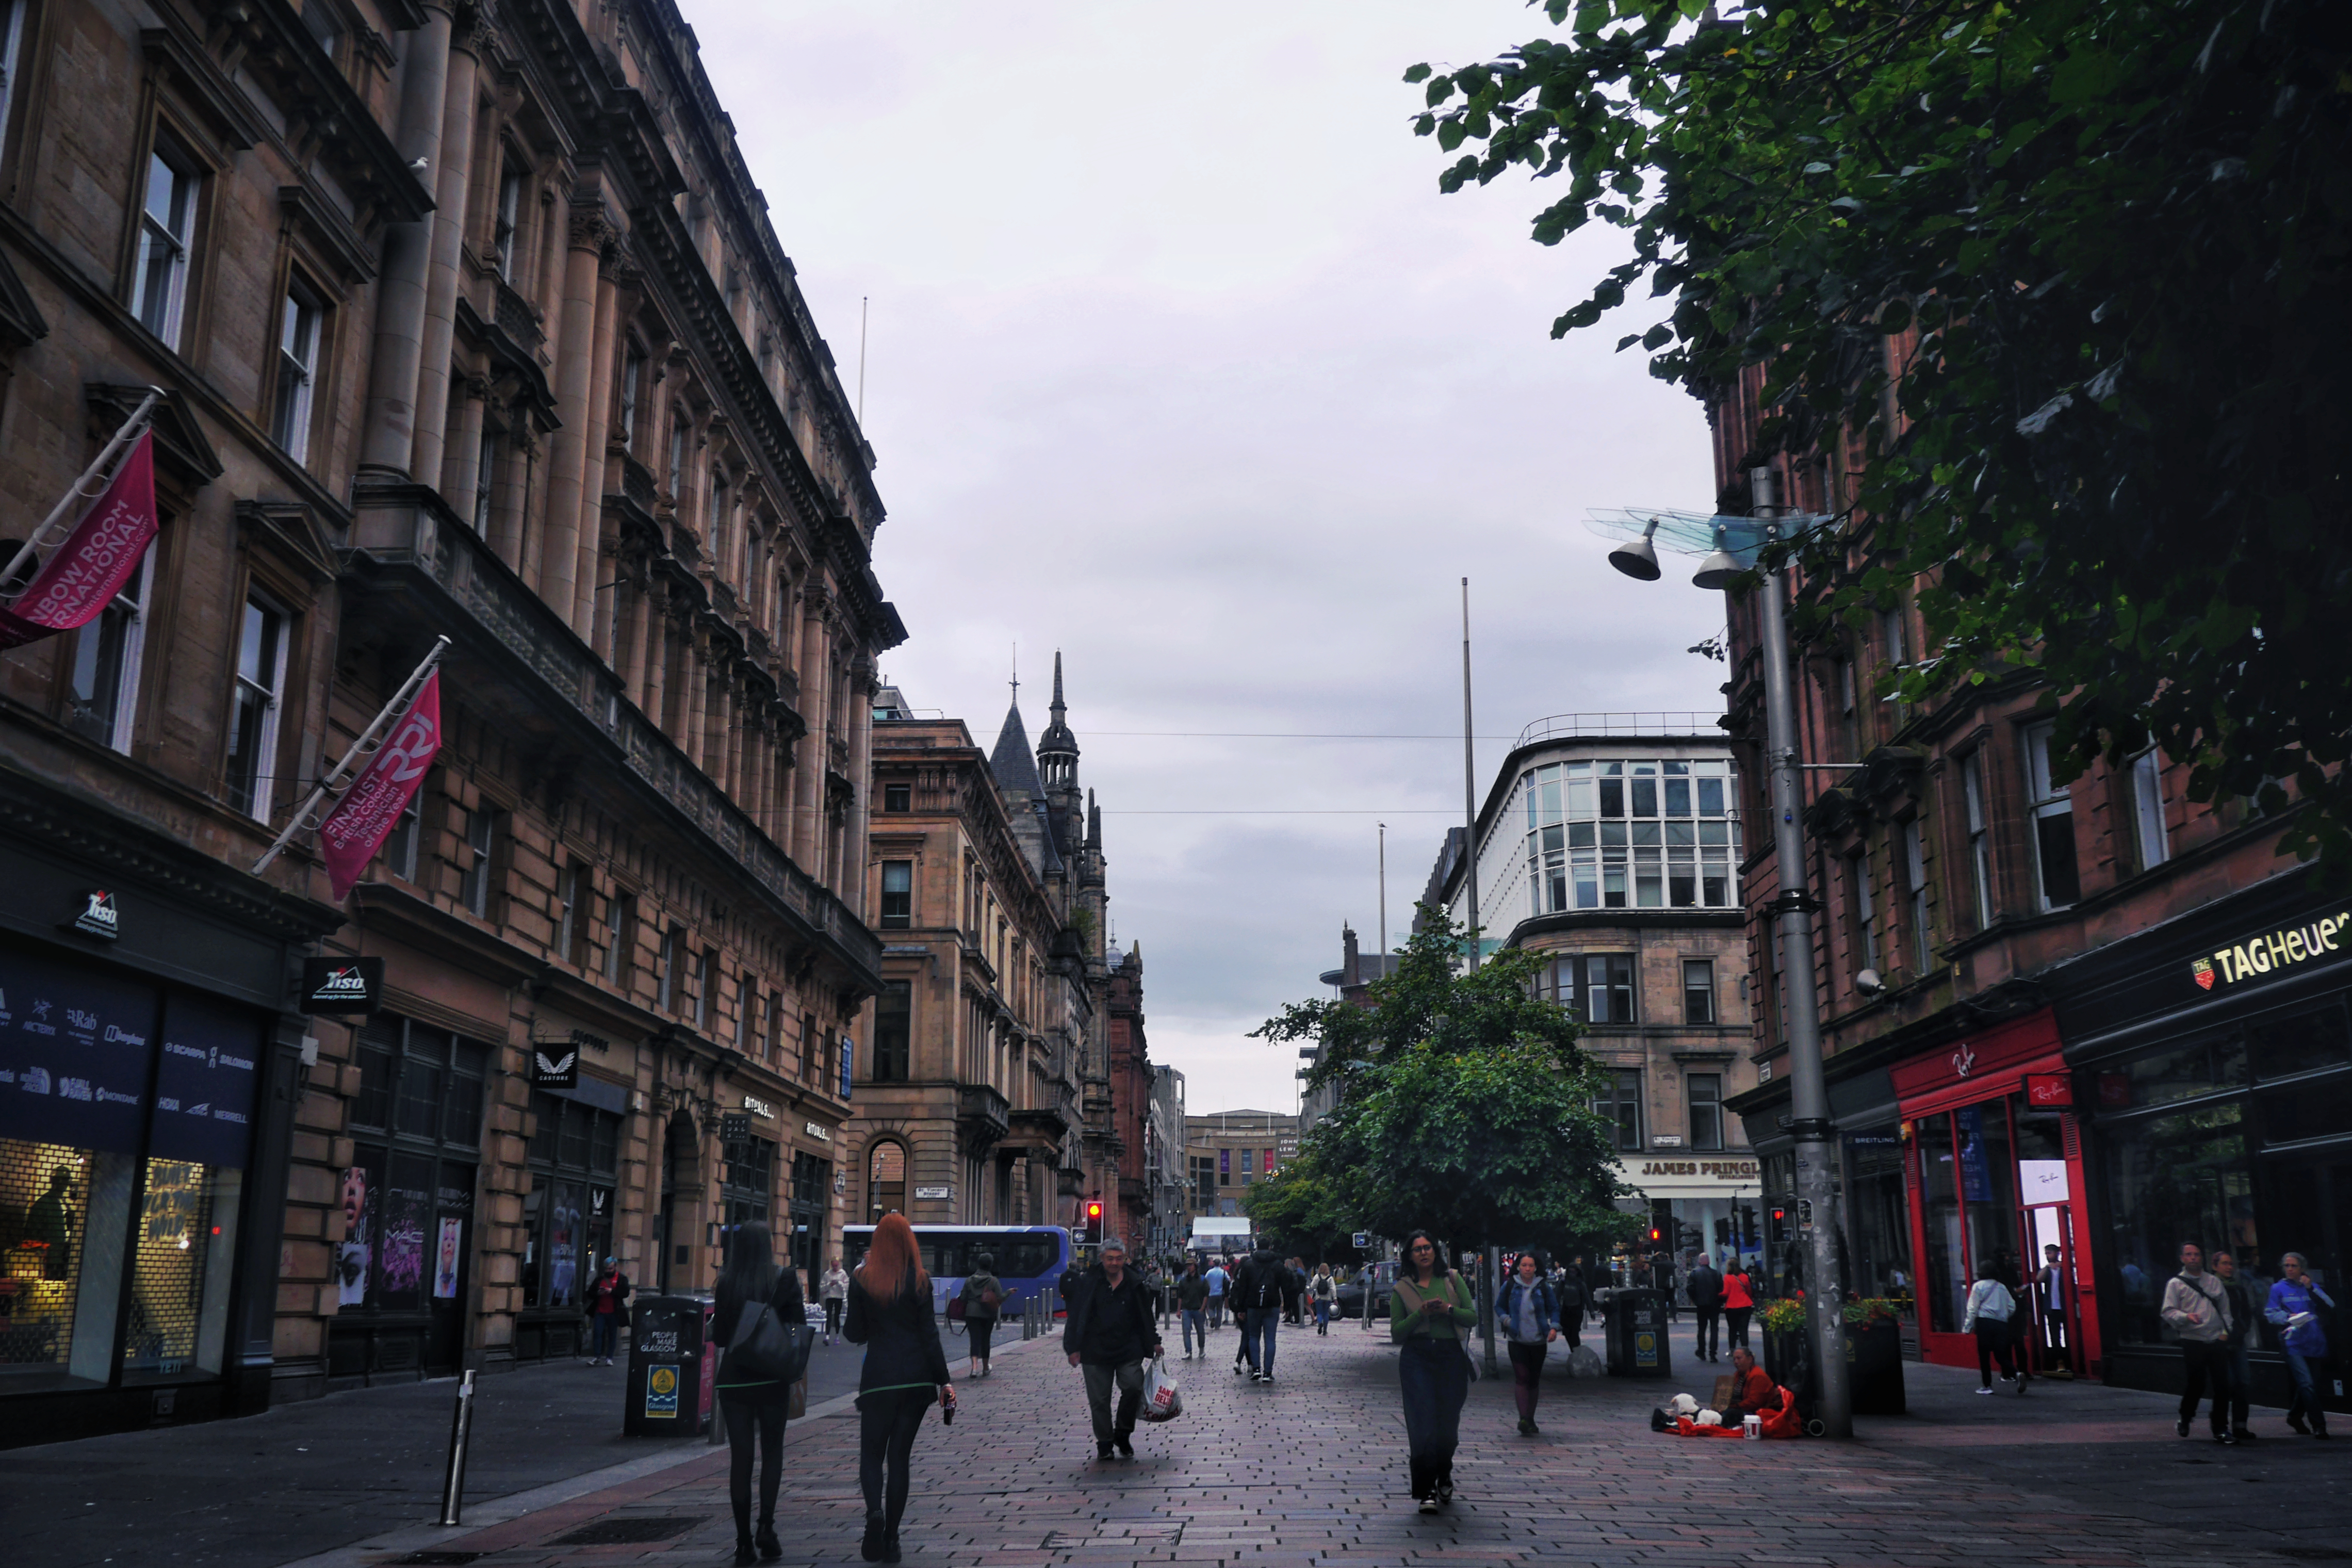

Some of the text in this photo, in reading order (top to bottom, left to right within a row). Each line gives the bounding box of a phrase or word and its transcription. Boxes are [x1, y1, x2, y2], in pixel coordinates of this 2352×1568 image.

[78, 499, 129, 563] ROOM
[326, 772, 380, 838] FINALIST
[354, 787, 400, 839] Technician
[333, 780, 389, 850] British Colour
[364, 792, 407, 847] of the Year
[88, 893, 118, 924] Tiso
[2193, 960, 2211, 972] TAG
[326, 971, 365, 989] Tiso
[75, 1010, 97, 1030] Rab
[173, 1044, 206, 1059] SCARPA
[219, 1054, 254, 1070] SALOMON
[158, 1097, 179, 1112] HOKA
[214, 1109, 248, 1123] MERRELL
[1642, 1163, 1697, 1175] JAMES
[159, 1359, 181, 1374] YETI
[648, 1402, 675, 1410] Glasgow
